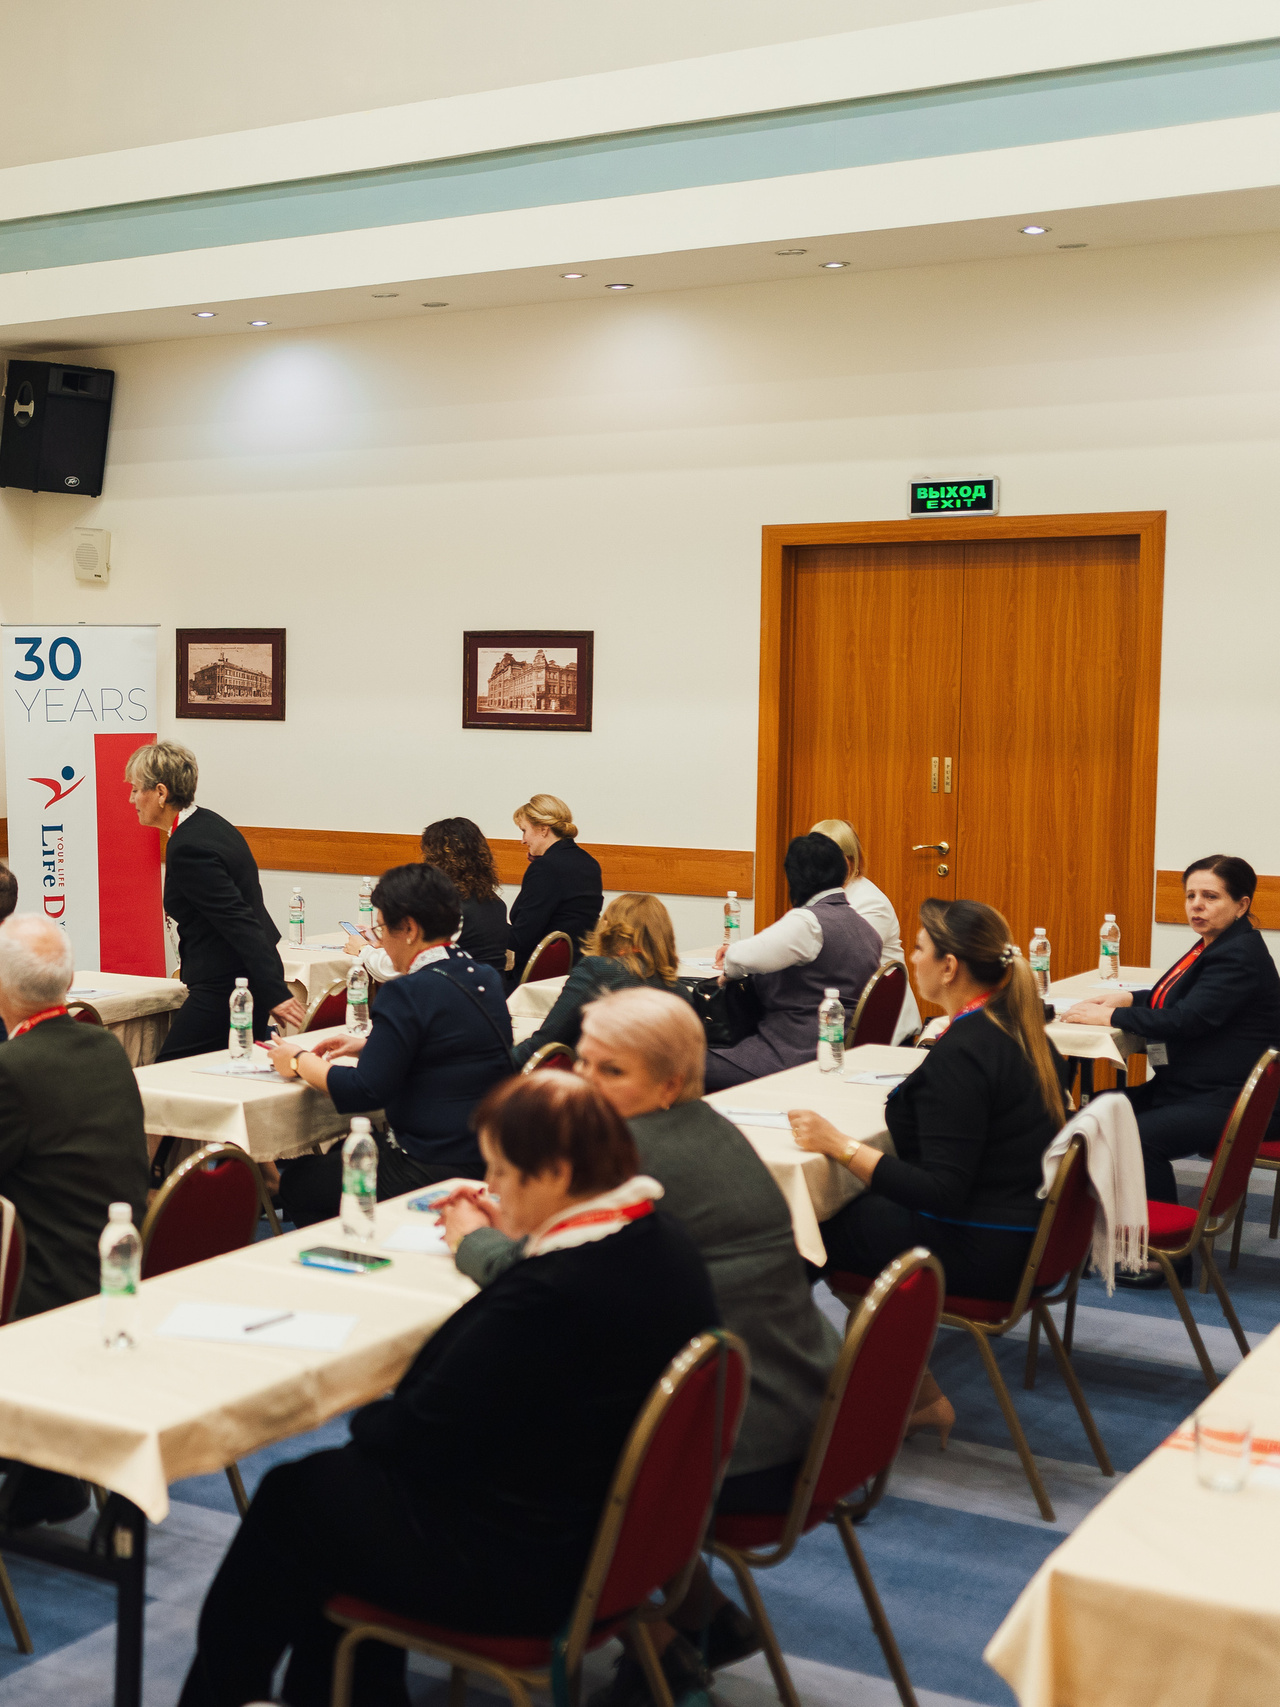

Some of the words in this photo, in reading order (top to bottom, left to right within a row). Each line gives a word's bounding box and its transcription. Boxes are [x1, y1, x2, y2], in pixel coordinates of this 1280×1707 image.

[916, 484, 987, 499] ВЫХОД
[926, 498, 976, 509] EXIT
[14, 636, 82, 682] 30
[14, 687, 149, 723] YEARS
[57, 836, 65, 864] YOUR
[57, 868, 65, 887] LIFE
